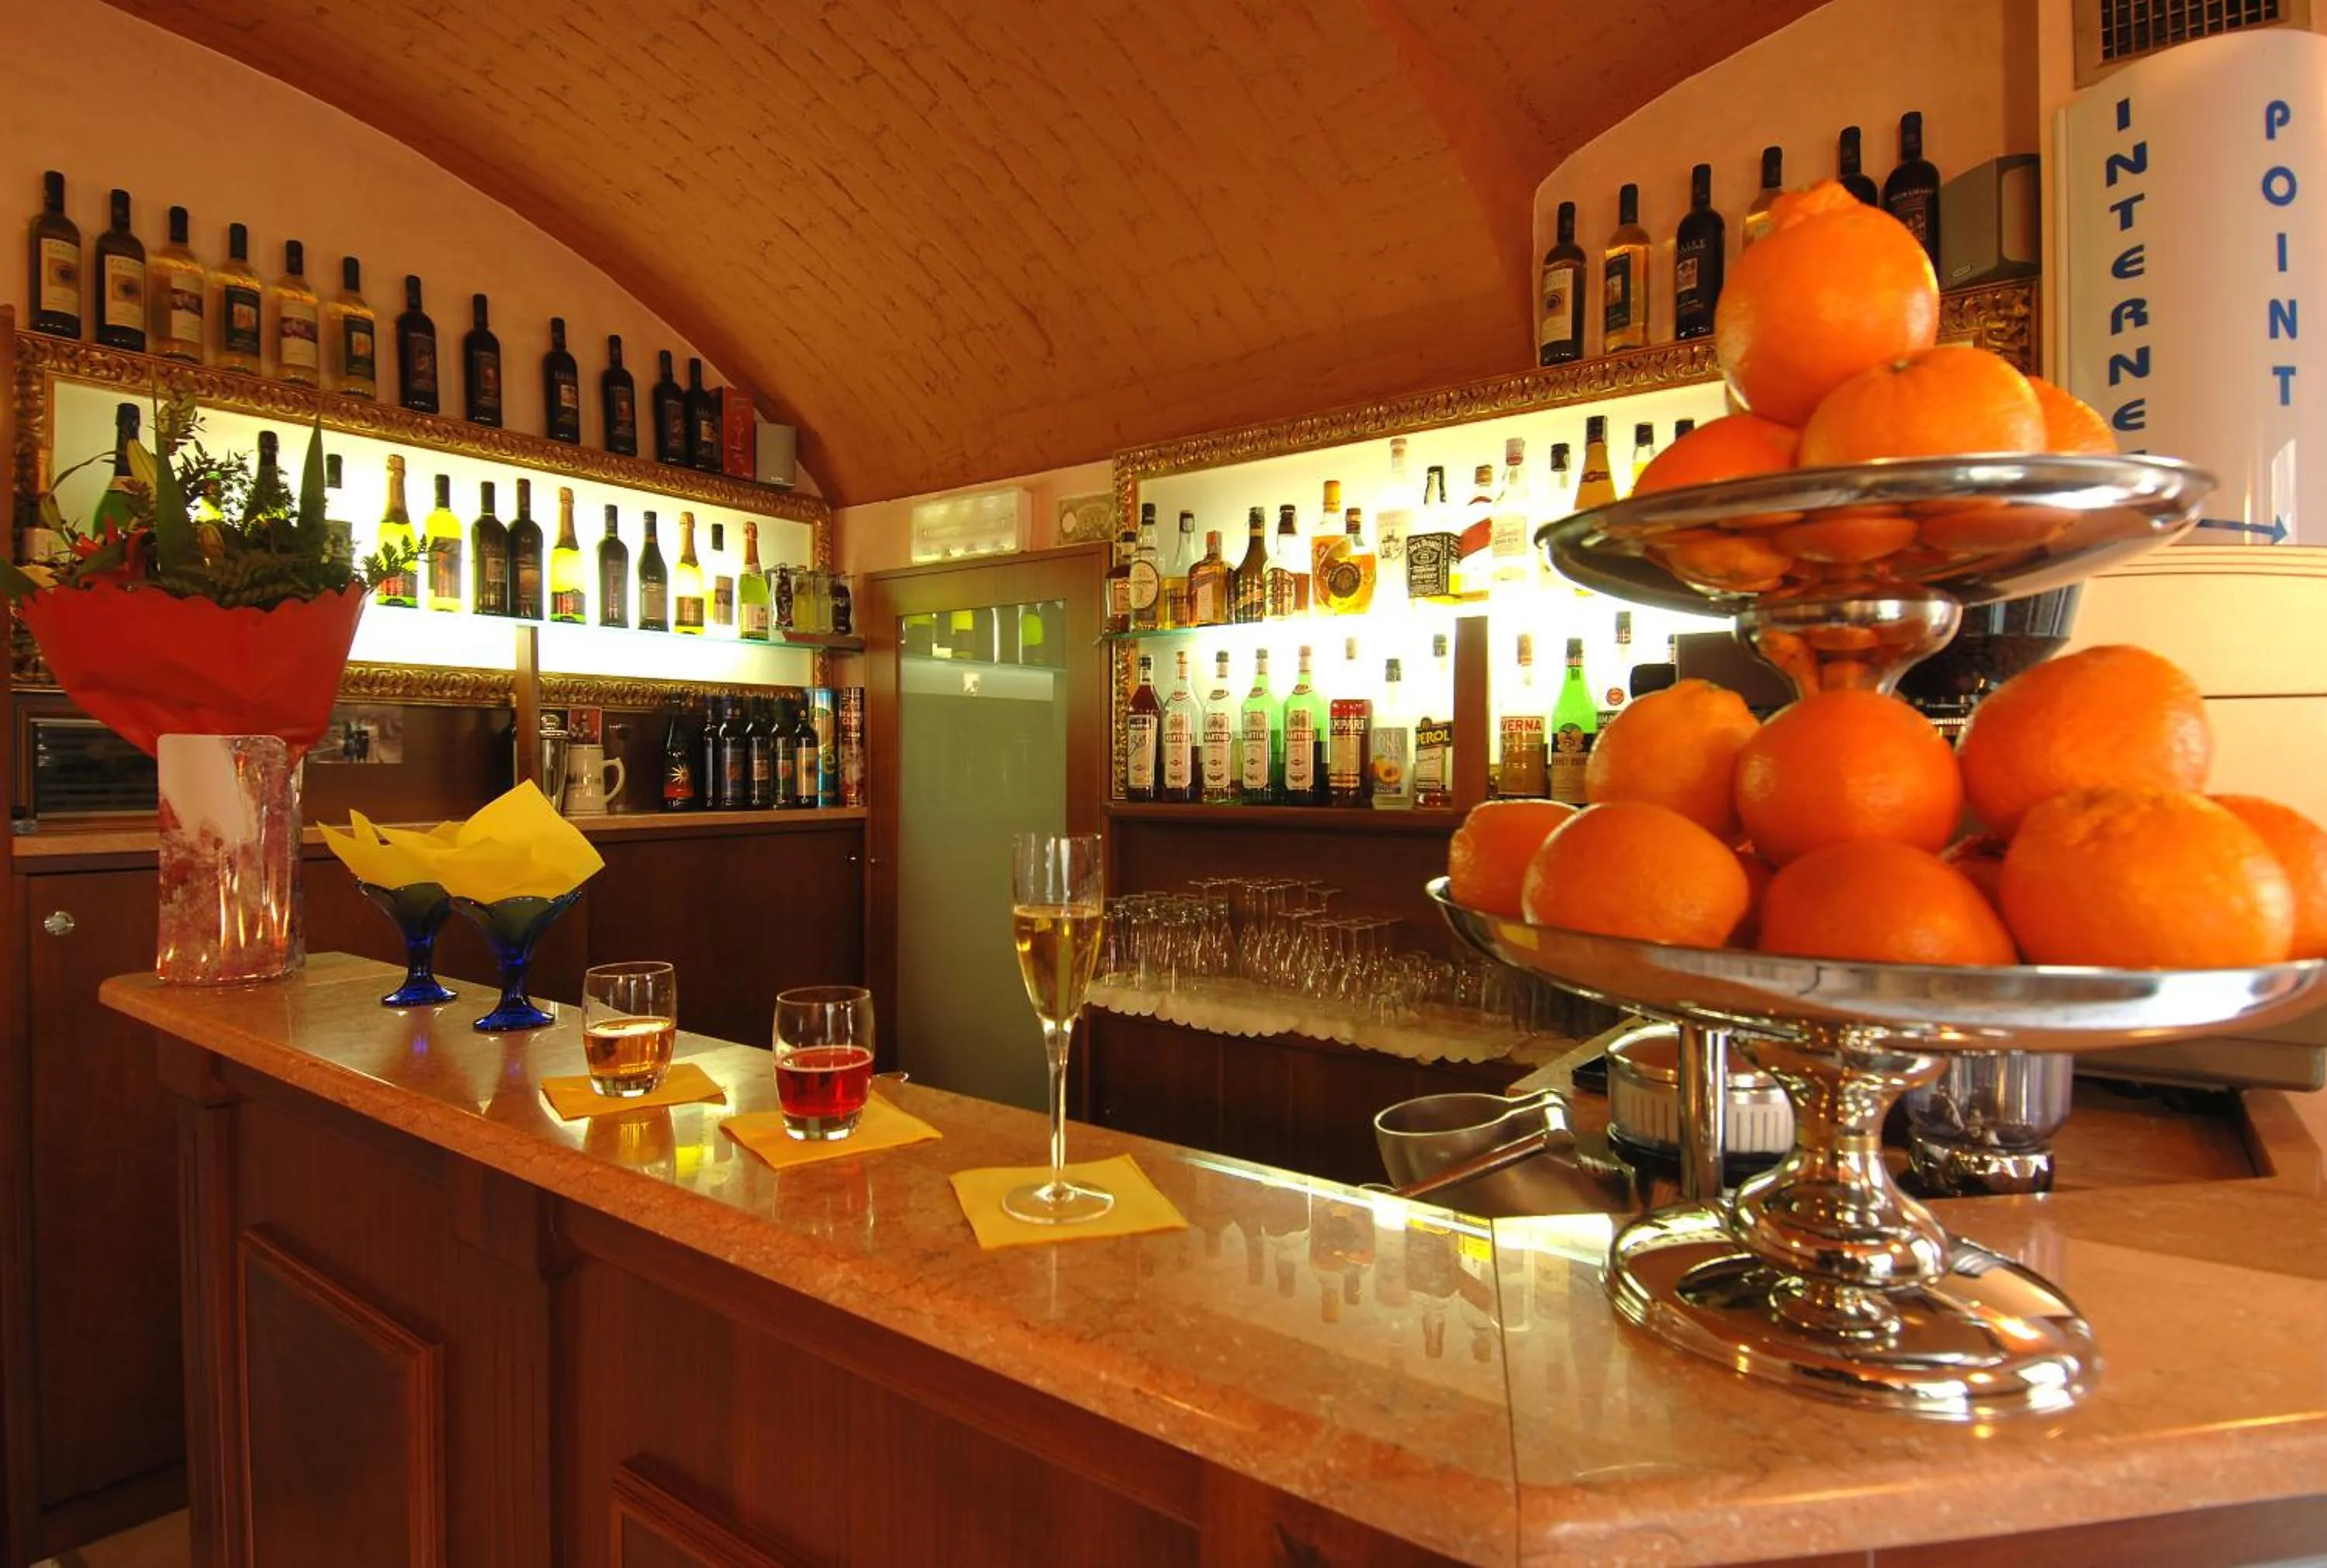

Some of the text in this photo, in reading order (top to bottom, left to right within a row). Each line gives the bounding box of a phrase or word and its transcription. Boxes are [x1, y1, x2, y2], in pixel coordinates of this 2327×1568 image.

[2105, 97, 2150, 454] INTERNE
[2261, 99, 2298, 406] POINT
[1417, 730, 1450, 744] PEROL
[1501, 718, 1542, 732] VERNA
